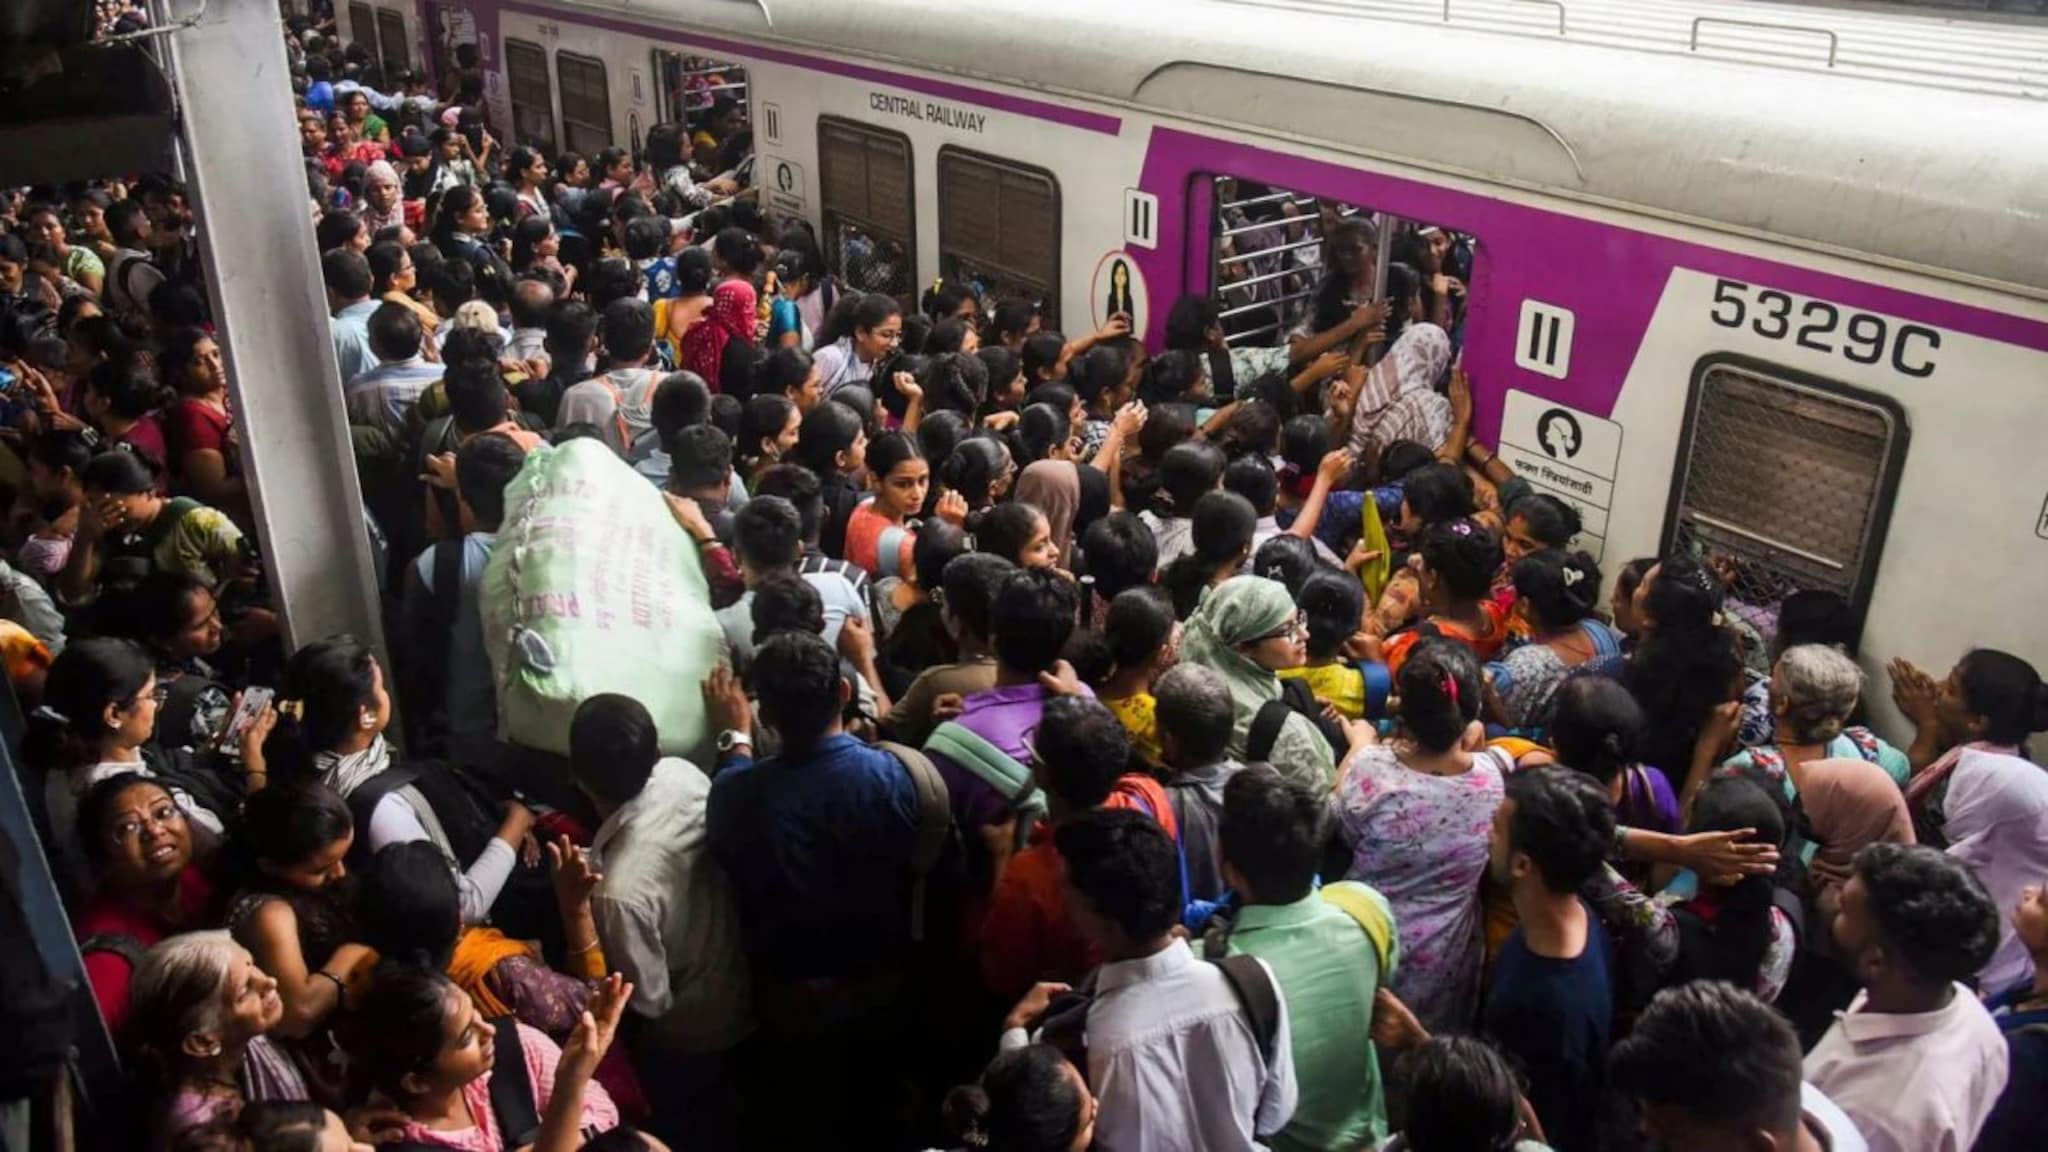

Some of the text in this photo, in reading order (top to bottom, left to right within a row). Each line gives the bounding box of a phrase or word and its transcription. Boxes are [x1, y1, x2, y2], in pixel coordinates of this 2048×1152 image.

[869, 92, 986, 133] CENTRAL RAILWAY
[1132, 198, 1149, 240] II
[1529, 311, 1560, 366] II
[1710, 278, 1941, 378] 5329C
